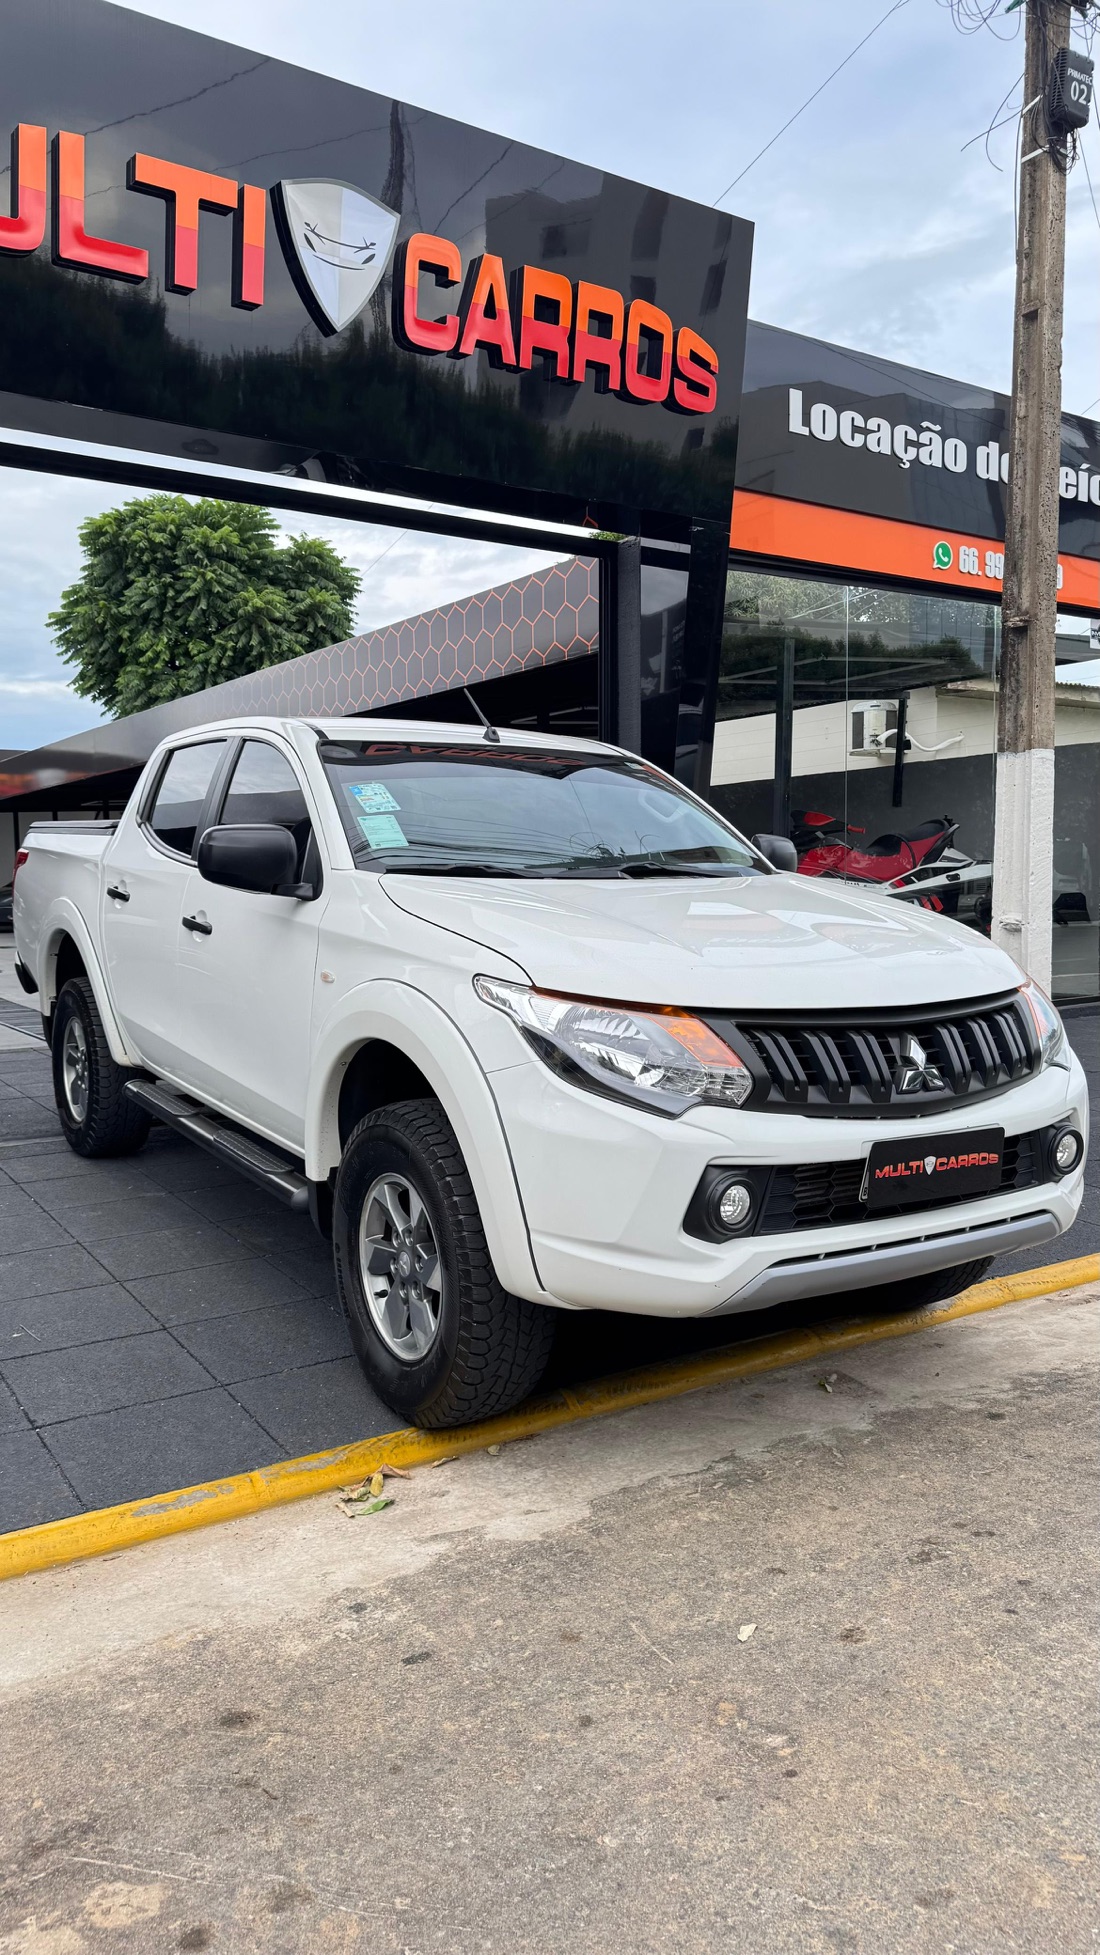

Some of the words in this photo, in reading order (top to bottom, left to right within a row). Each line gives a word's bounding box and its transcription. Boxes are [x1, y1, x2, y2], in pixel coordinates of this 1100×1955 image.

[1070, 81, 1087, 105] 02
[398, 232, 720, 413] CARROS
[788, 387, 968, 473] Locação
[959, 545, 982, 576] 66.
[874, 1160, 924, 1179] MULTI
[936, 1152, 999, 1171] CARROS
